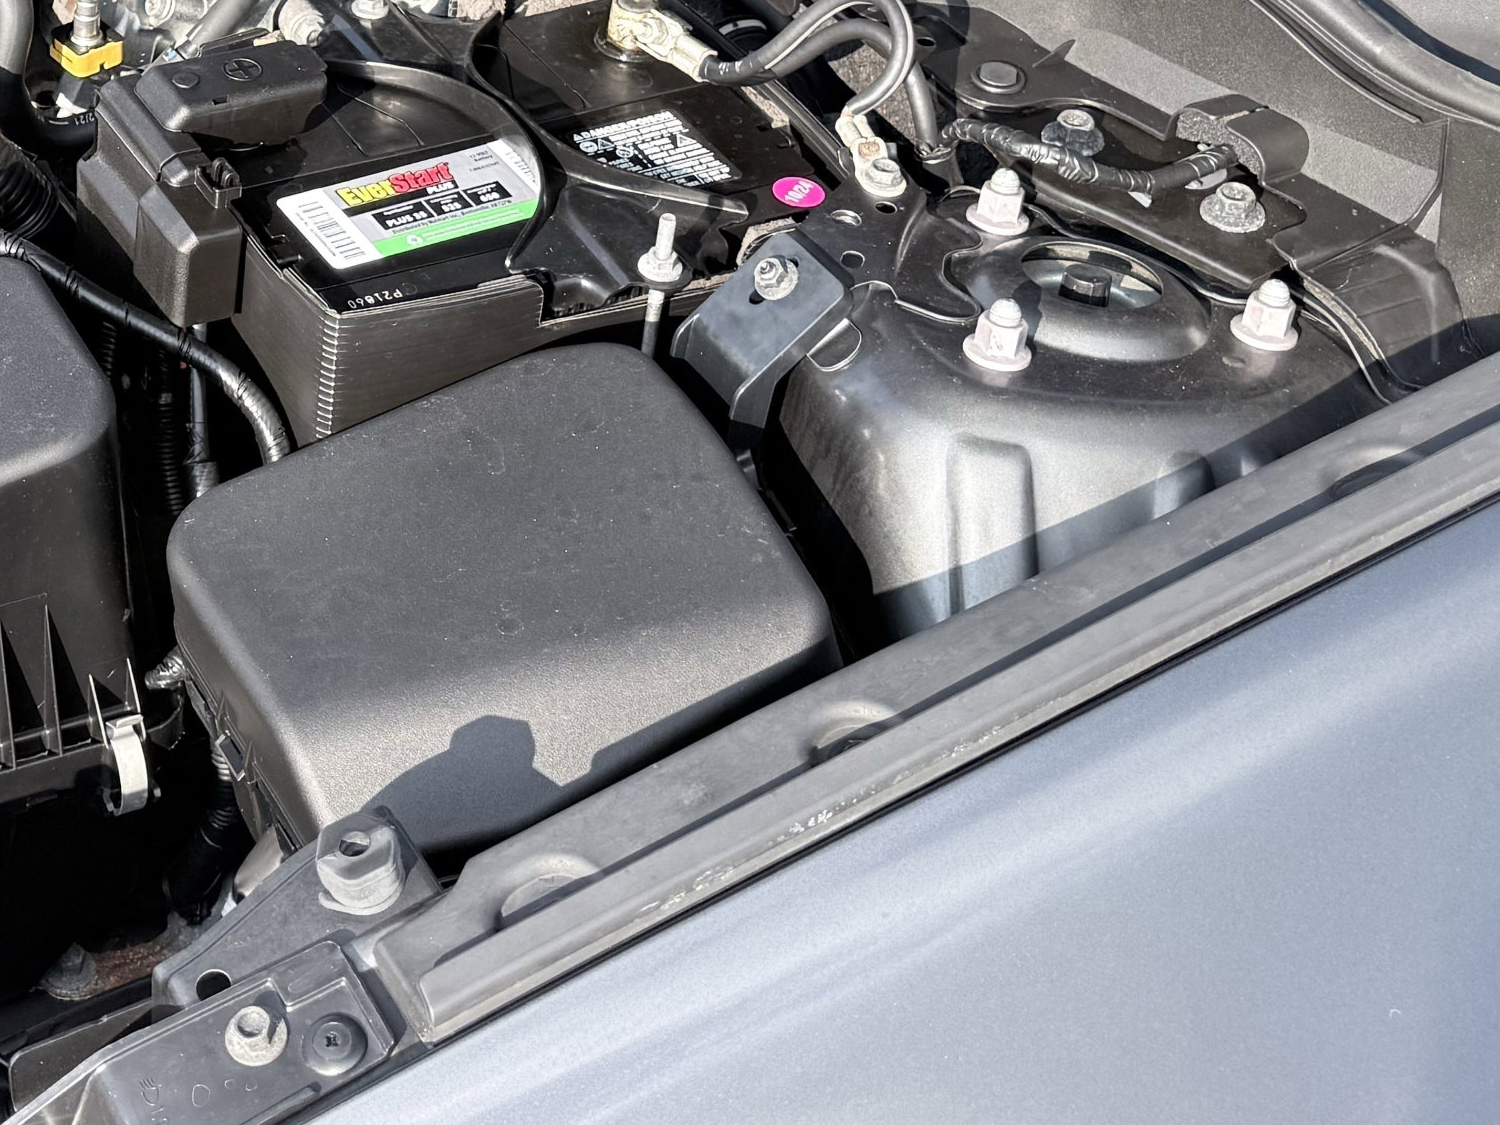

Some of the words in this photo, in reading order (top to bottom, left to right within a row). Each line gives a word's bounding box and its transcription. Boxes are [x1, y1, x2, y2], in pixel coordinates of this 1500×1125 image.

[335, 161, 454, 207] EverStart
[426, 181, 456, 195] PLUS
[385, 214, 412, 228] PLUS
